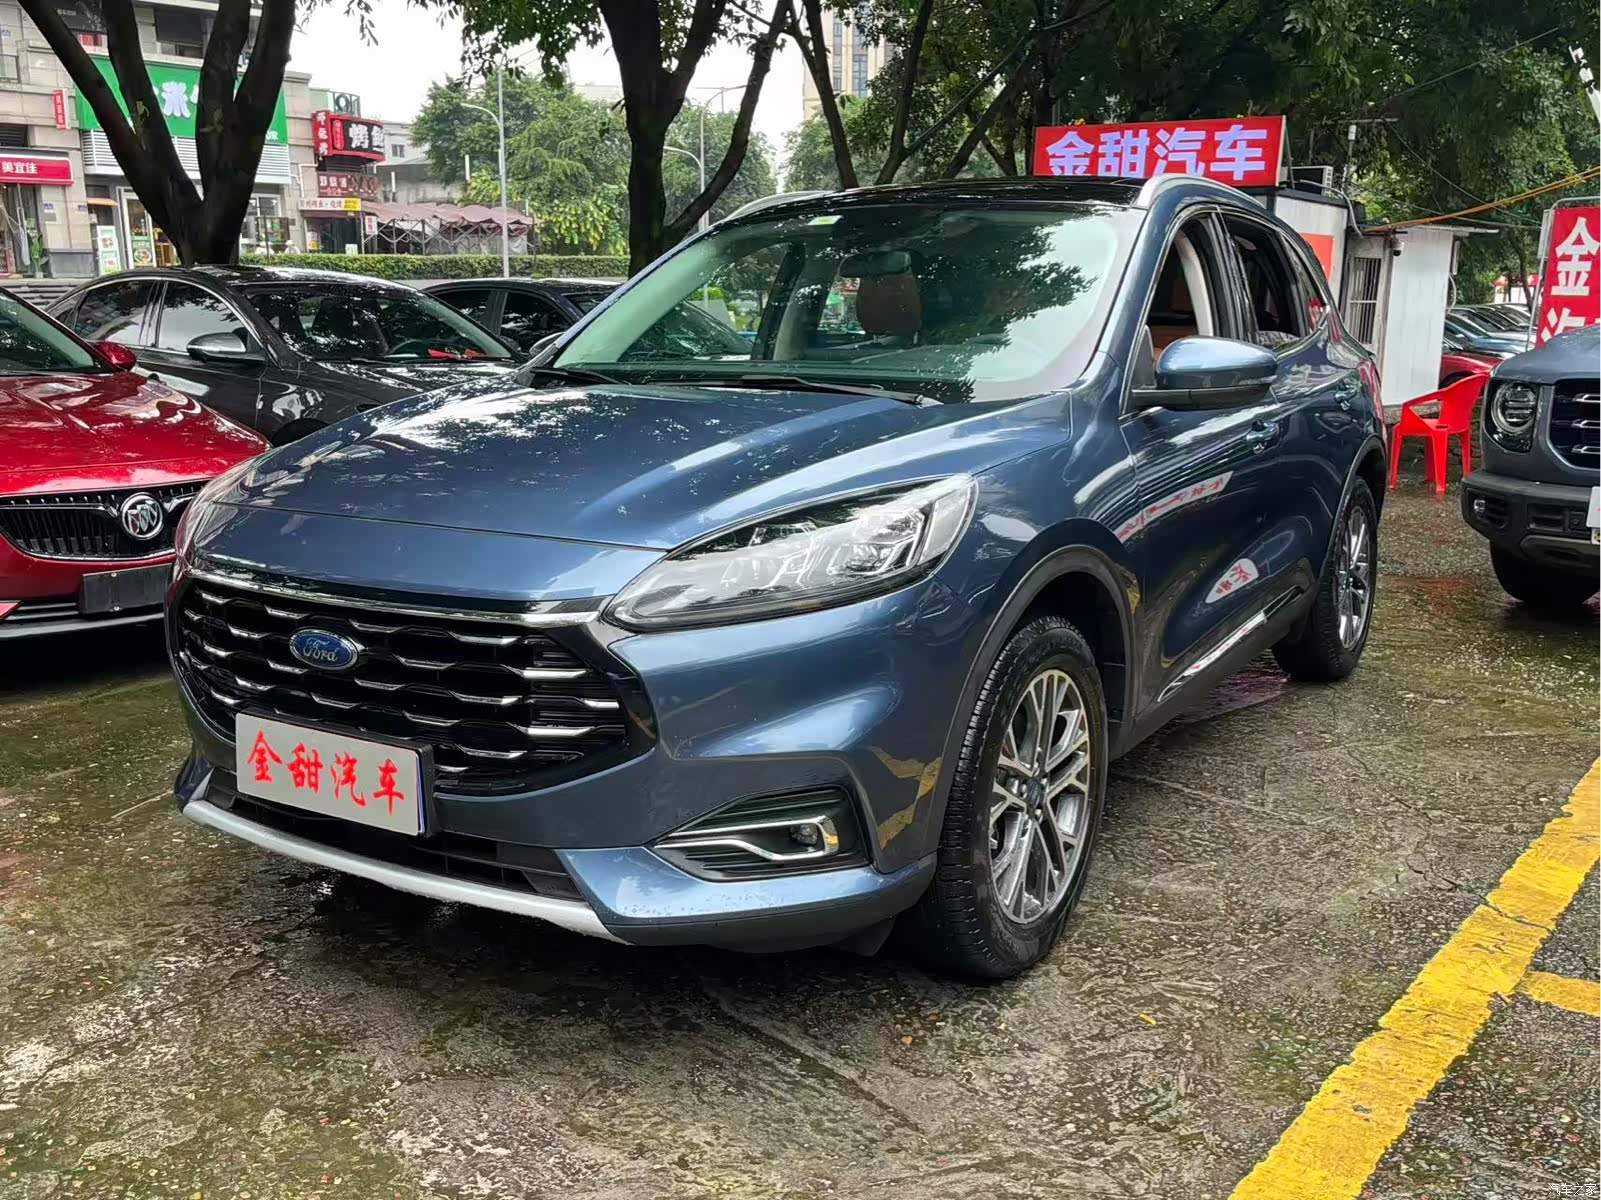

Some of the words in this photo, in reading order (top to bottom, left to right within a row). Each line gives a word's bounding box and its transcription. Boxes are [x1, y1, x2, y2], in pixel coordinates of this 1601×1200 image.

[2, 161, 38, 174] 美宜佳
[1046, 124, 1268, 181] 金甜汽车
[1551, 216, 1600, 296] 金
[303, 637, 338, 662] Ford
[248, 731, 405, 816] 金甜汽车
